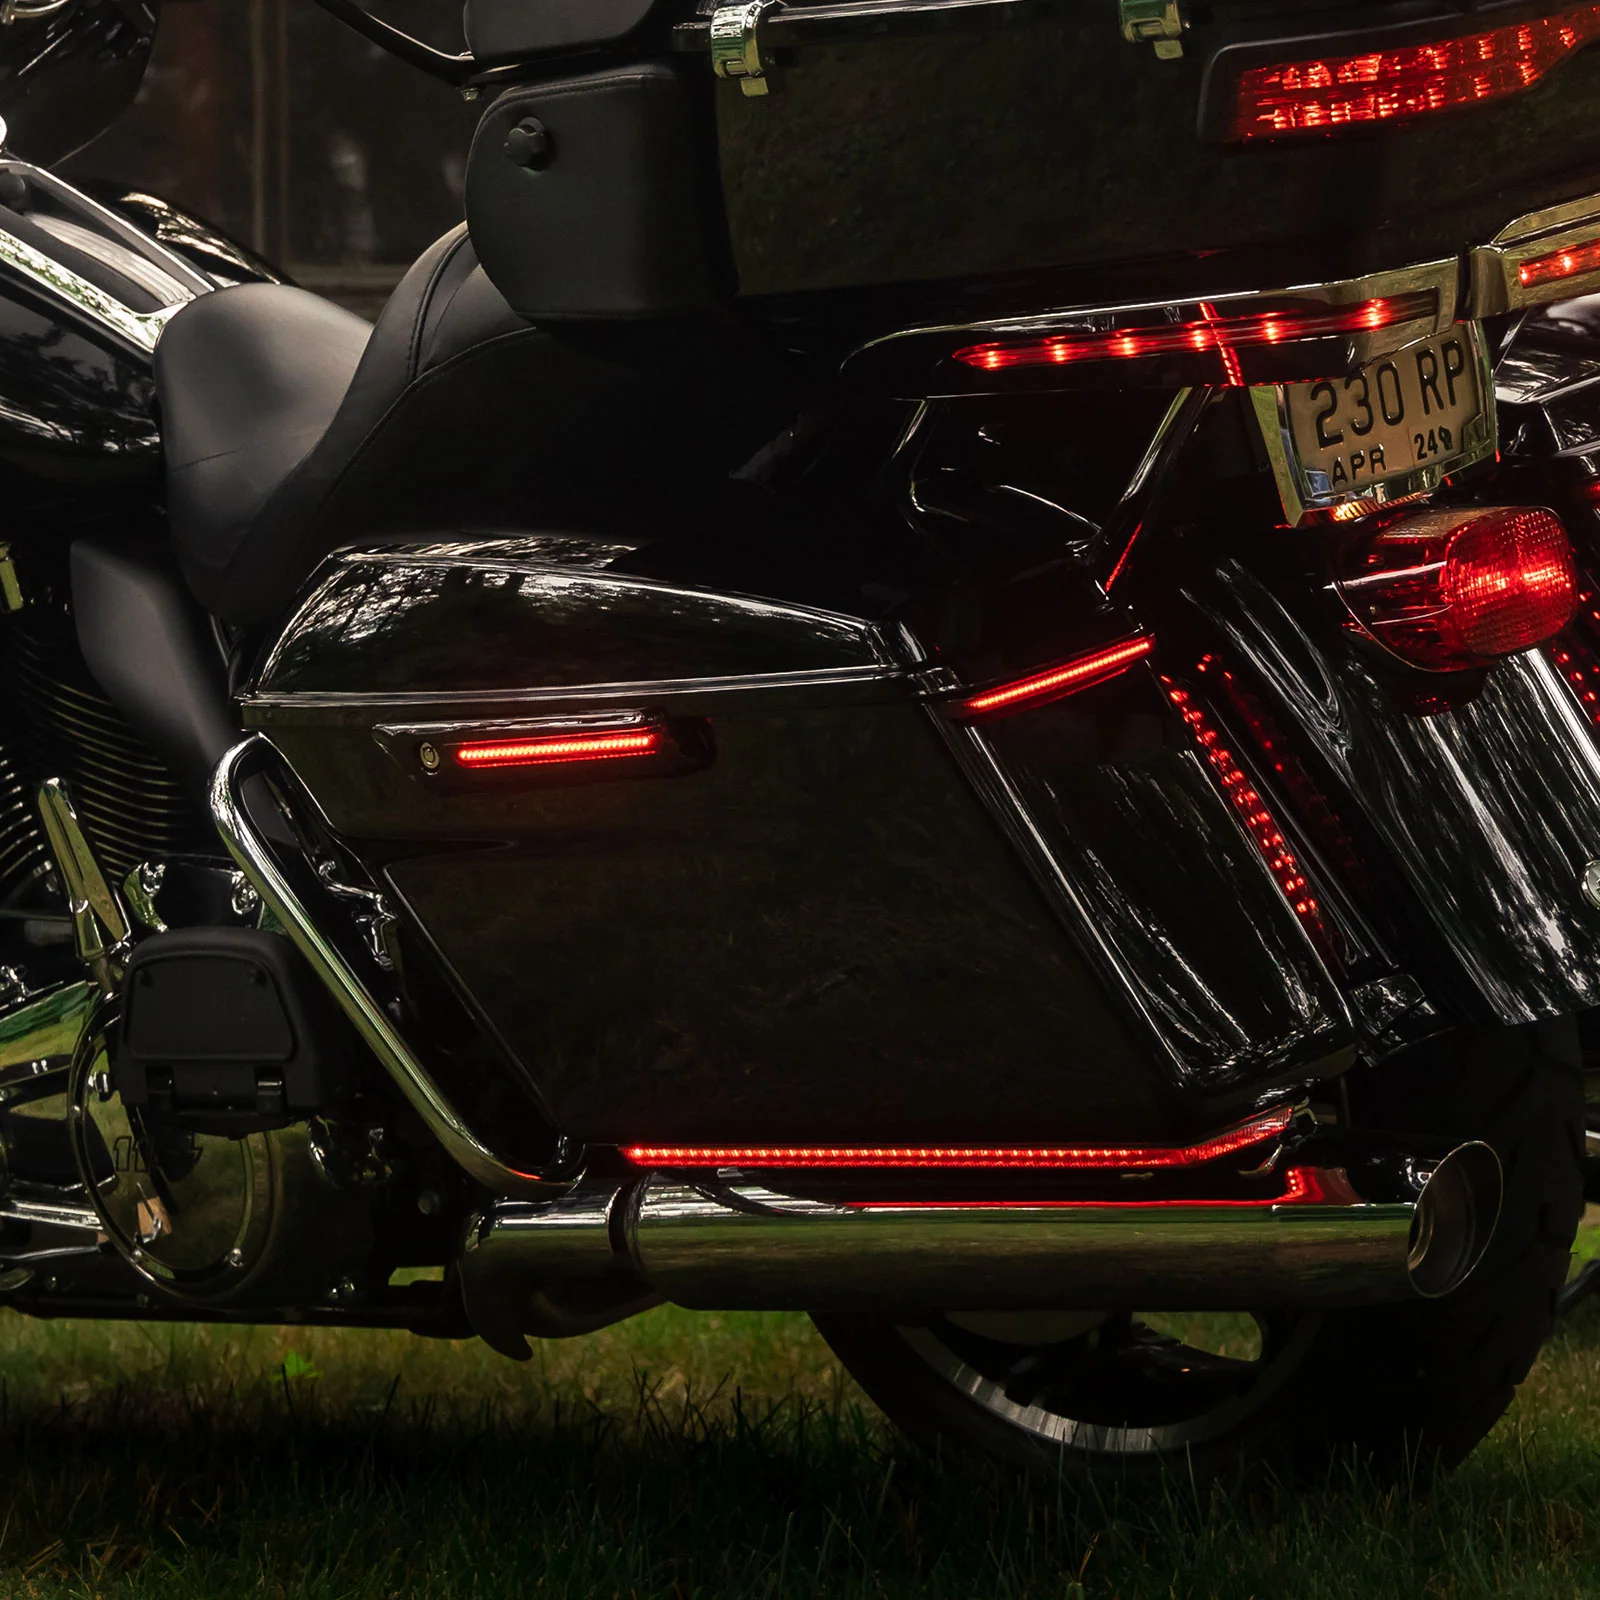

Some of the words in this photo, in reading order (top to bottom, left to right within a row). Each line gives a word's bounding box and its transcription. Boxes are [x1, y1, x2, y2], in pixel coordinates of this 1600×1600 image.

[1310, 363, 1405, 450] 230
[1415, 339, 1465, 416] RP
[1331, 447, 1387, 488] APR
[1413, 428, 1439, 461] 24
